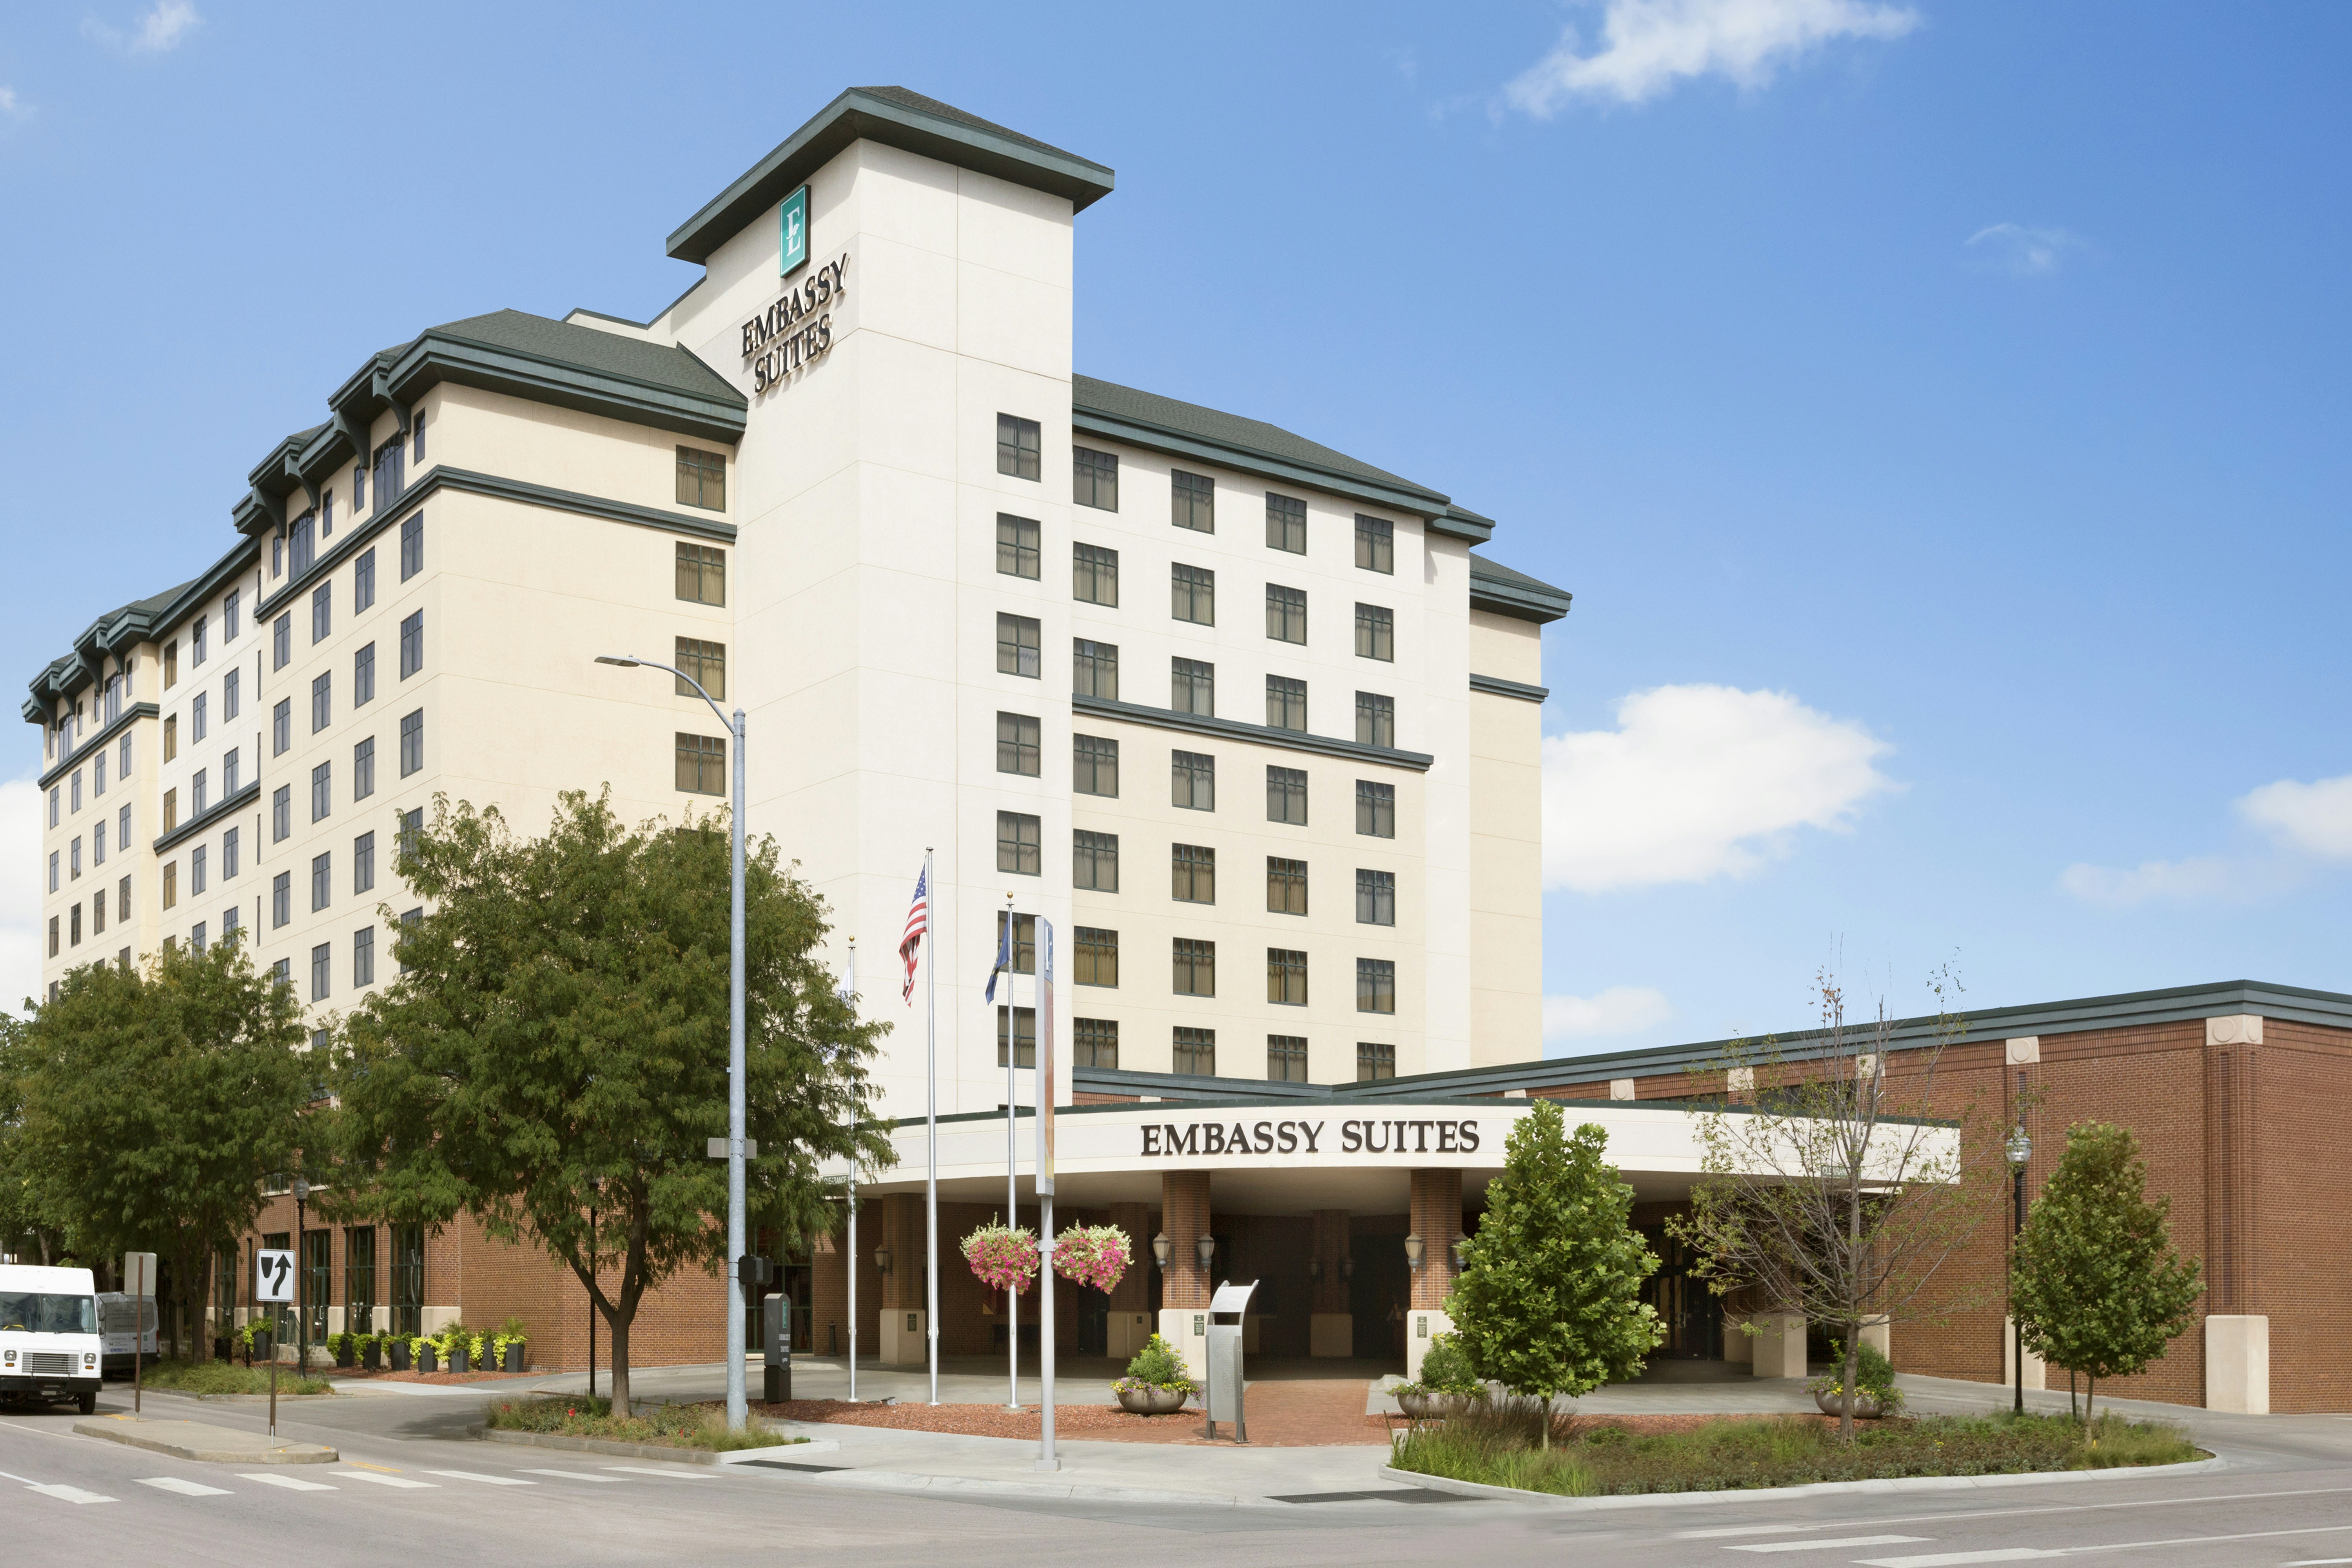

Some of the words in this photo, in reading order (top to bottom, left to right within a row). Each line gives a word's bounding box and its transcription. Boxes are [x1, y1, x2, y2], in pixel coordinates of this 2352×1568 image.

[742, 253, 847, 358] EMBASSY
[755, 313, 833, 392] SUITES
[1141, 1121, 1324, 1155] EMBASSY
[1342, 1120, 1480, 1152] SUITES
[1822, 1166, 1855, 1176] CLEARAN
